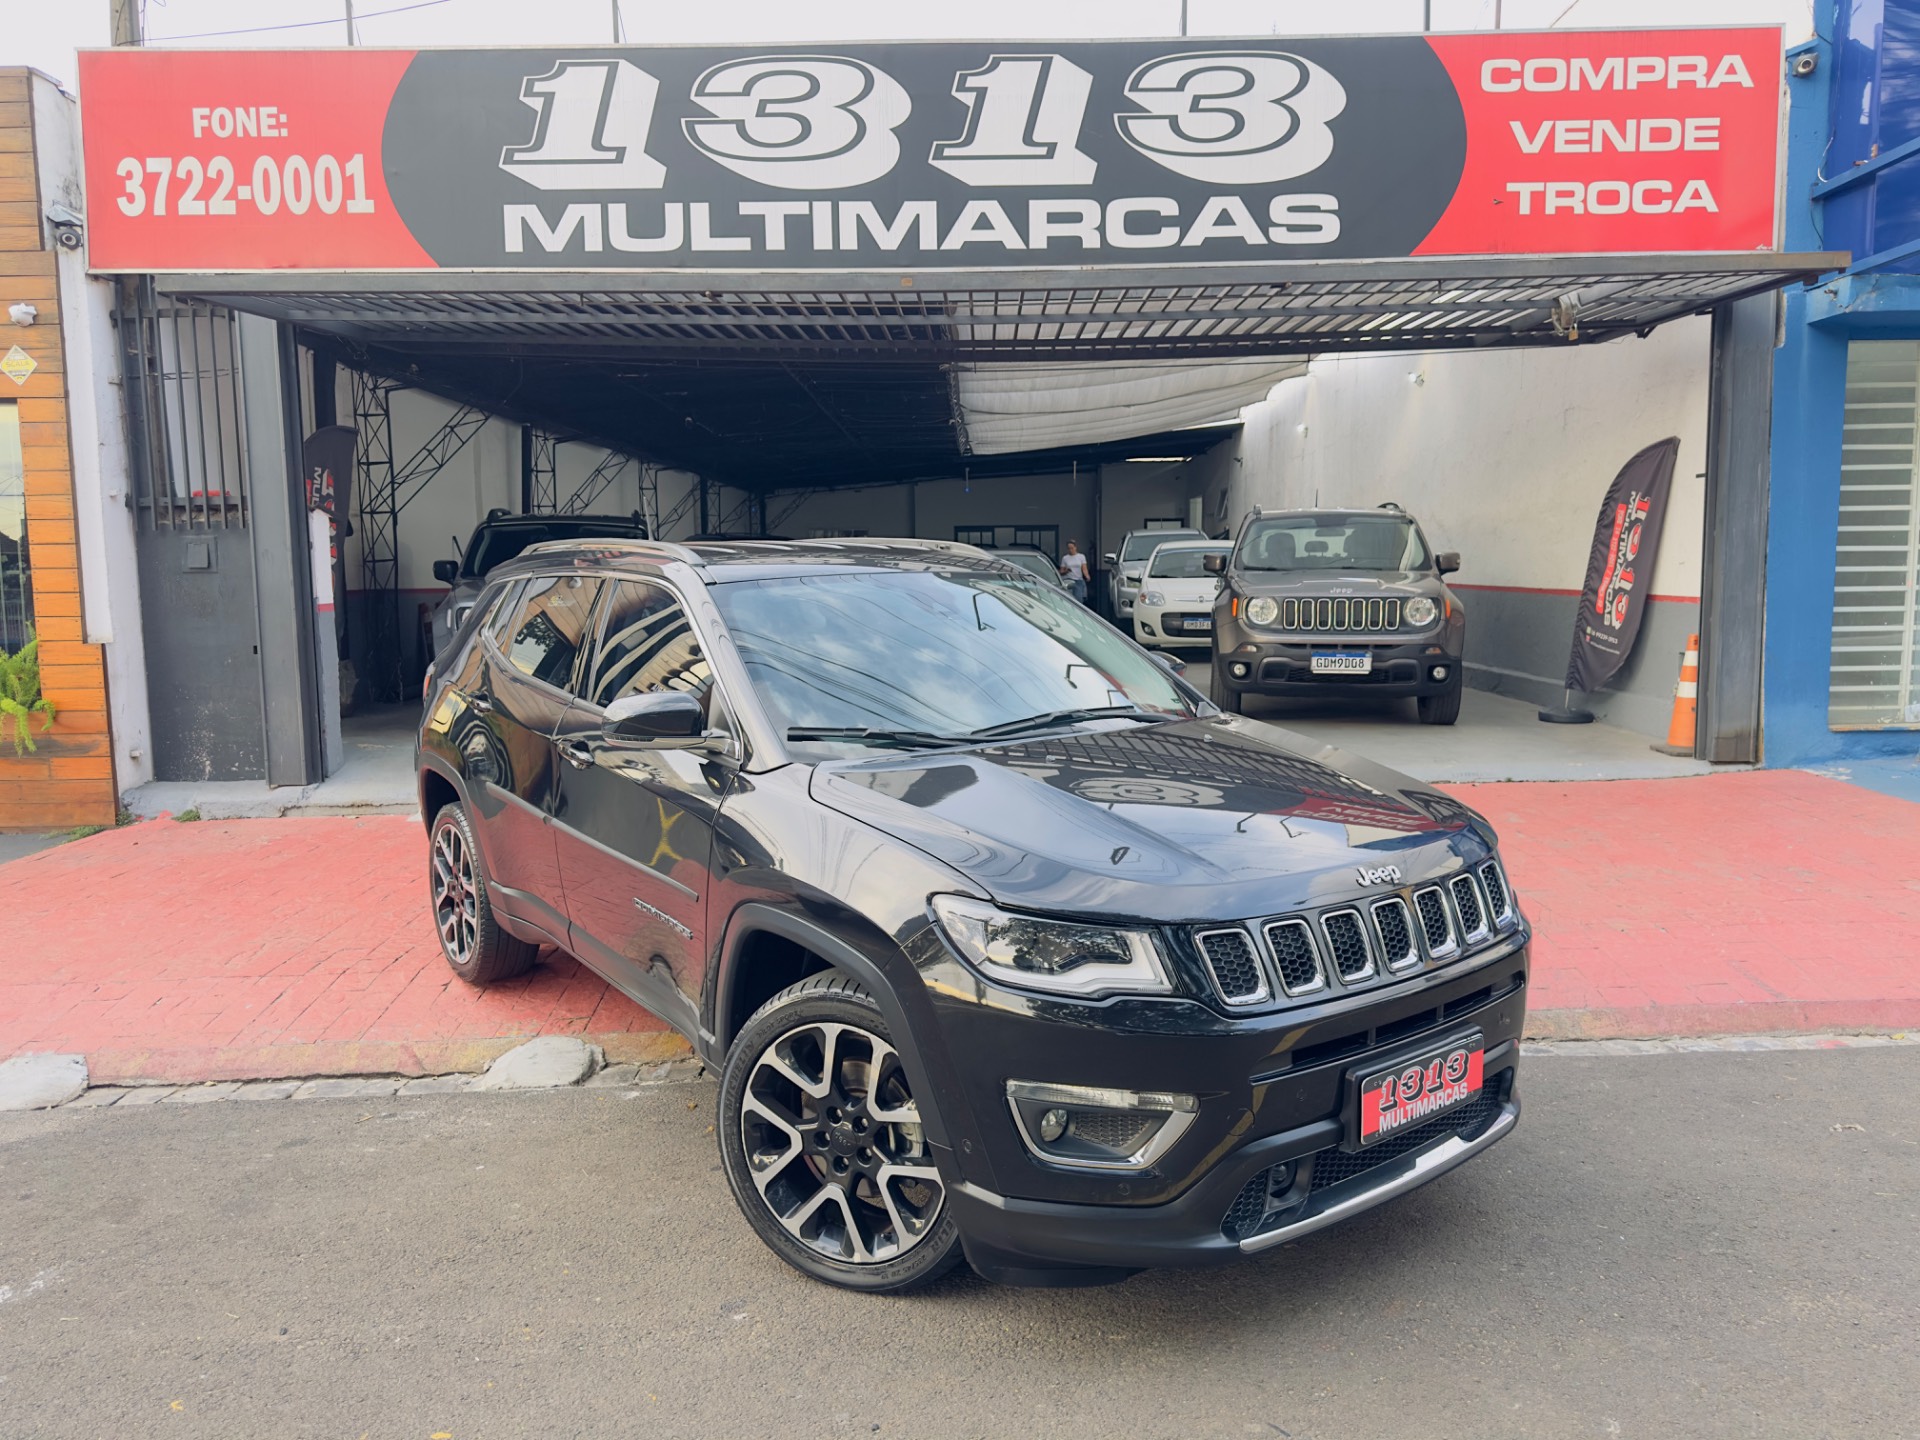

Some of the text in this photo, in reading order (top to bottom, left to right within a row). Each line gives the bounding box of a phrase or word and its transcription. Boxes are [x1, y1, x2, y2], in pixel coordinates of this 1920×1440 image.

[1480, 54, 1754, 93] COMPRA
[193, 106, 289, 138] FONE:
[499, 51, 1346, 191] 1313
[1509, 117, 1721, 154] VENDE
[116, 153, 375, 217] 3722-0001
[1506, 179, 1719, 215] TROCA
[503, 193, 1341, 253] MULTIMARCAS
[1604, 491, 1636, 626] MULTIMARCAS
[1316, 658, 1364, 669] GDM9D08
[1356, 865, 1401, 887] Jeep
[1379, 1049, 1470, 1113] 1313
[1378, 1082, 1469, 1133] MULTIMARCAS
